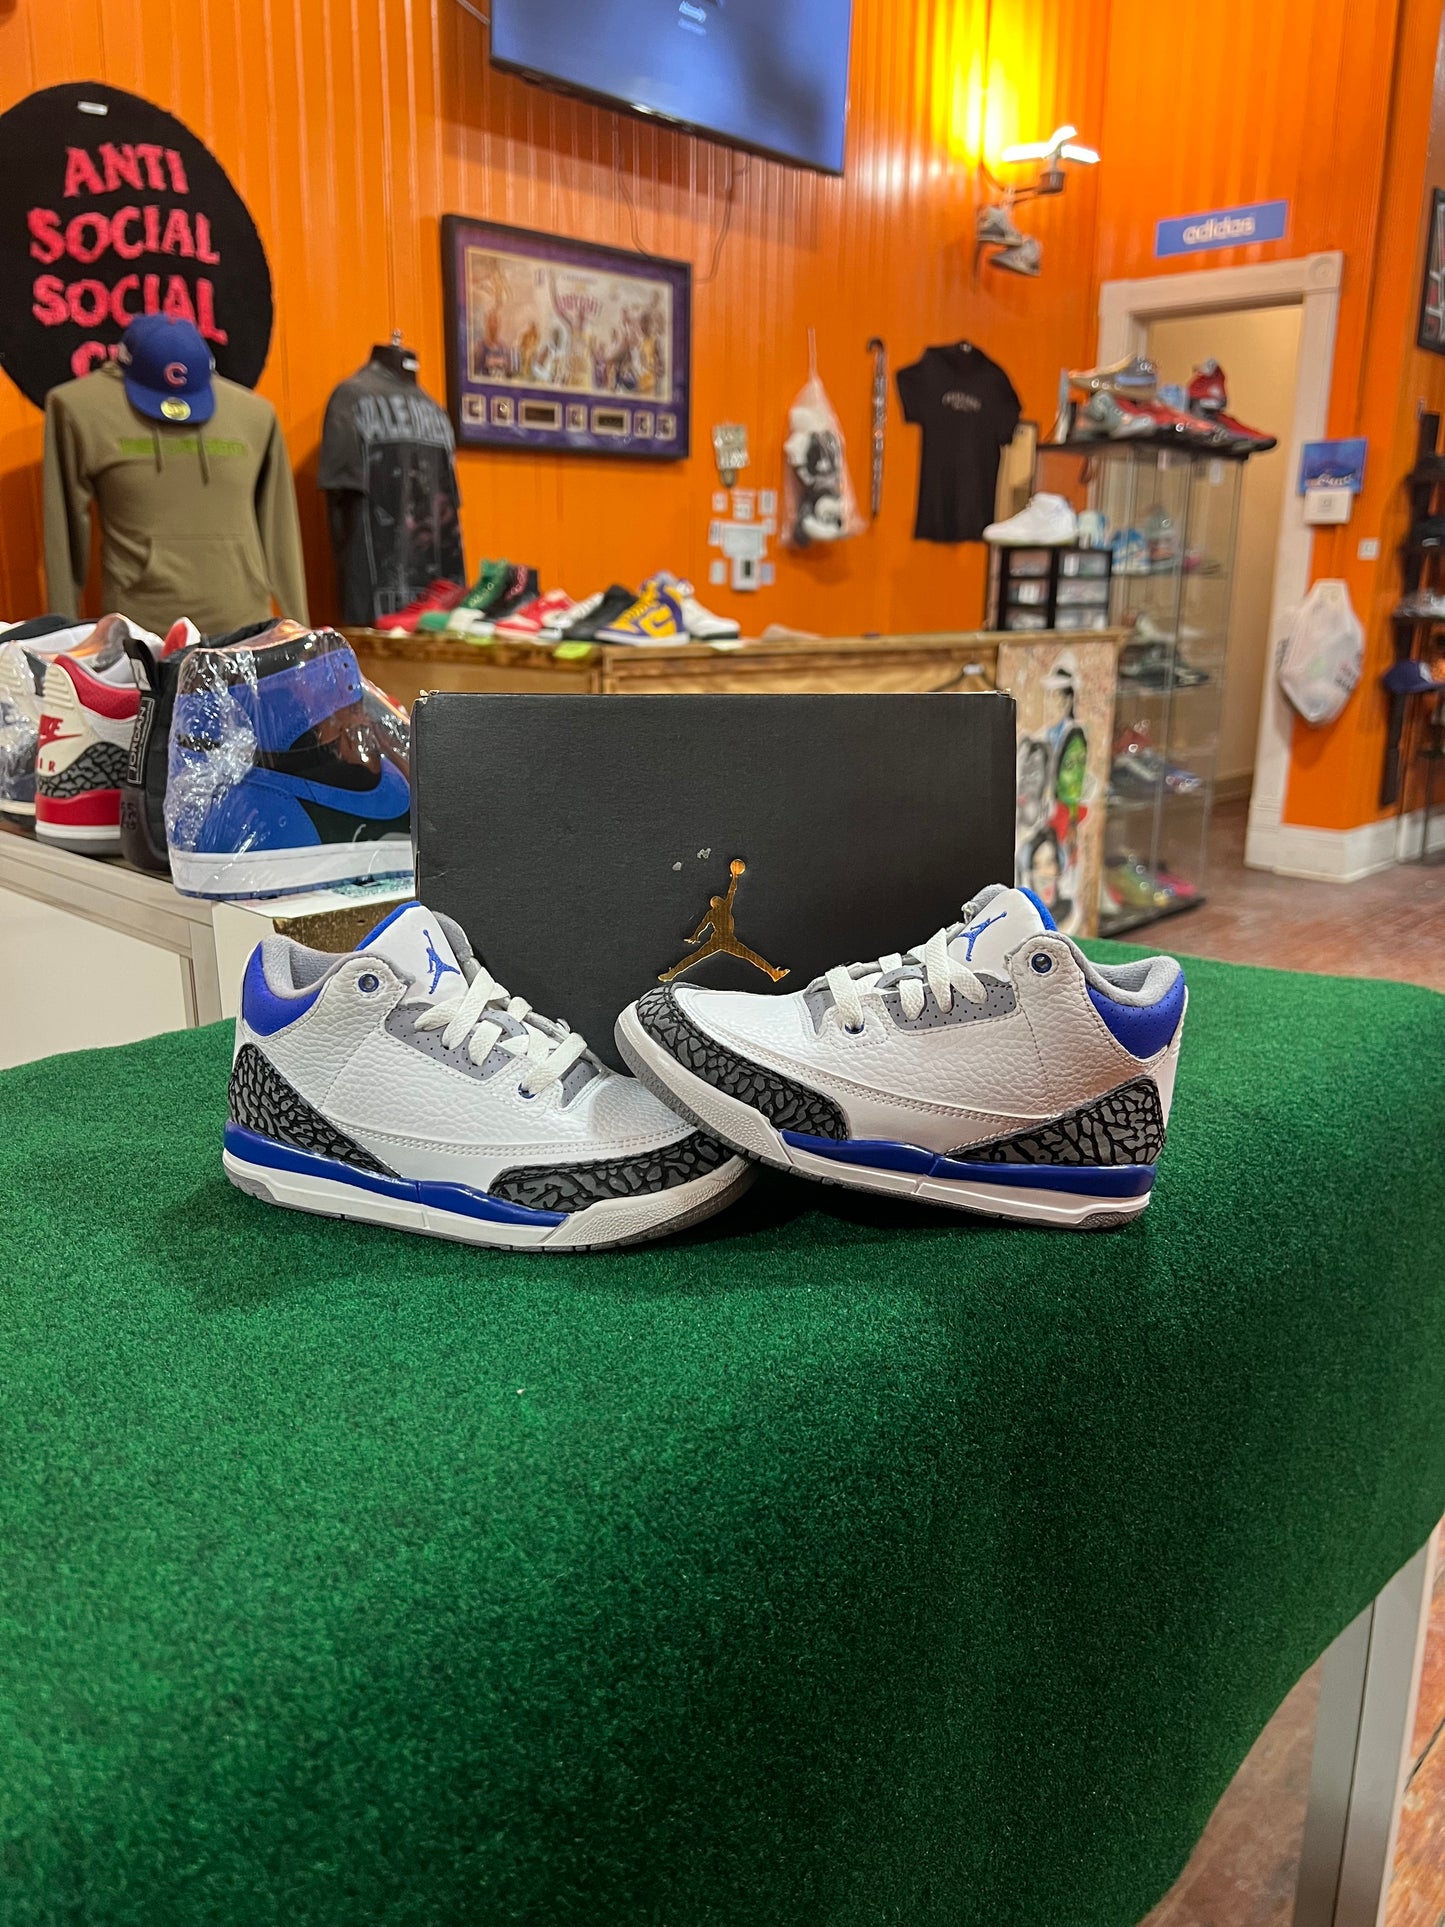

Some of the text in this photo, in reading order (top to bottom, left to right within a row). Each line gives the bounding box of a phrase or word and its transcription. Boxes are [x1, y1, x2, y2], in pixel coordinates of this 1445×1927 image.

[63, 143, 189, 197] ANTI
[27, 205, 220, 264] SOCIAL
[32, 274, 228, 345] SOCIAL
[164, 362, 188, 387] C
[129, 706, 147, 771] JORDAN
